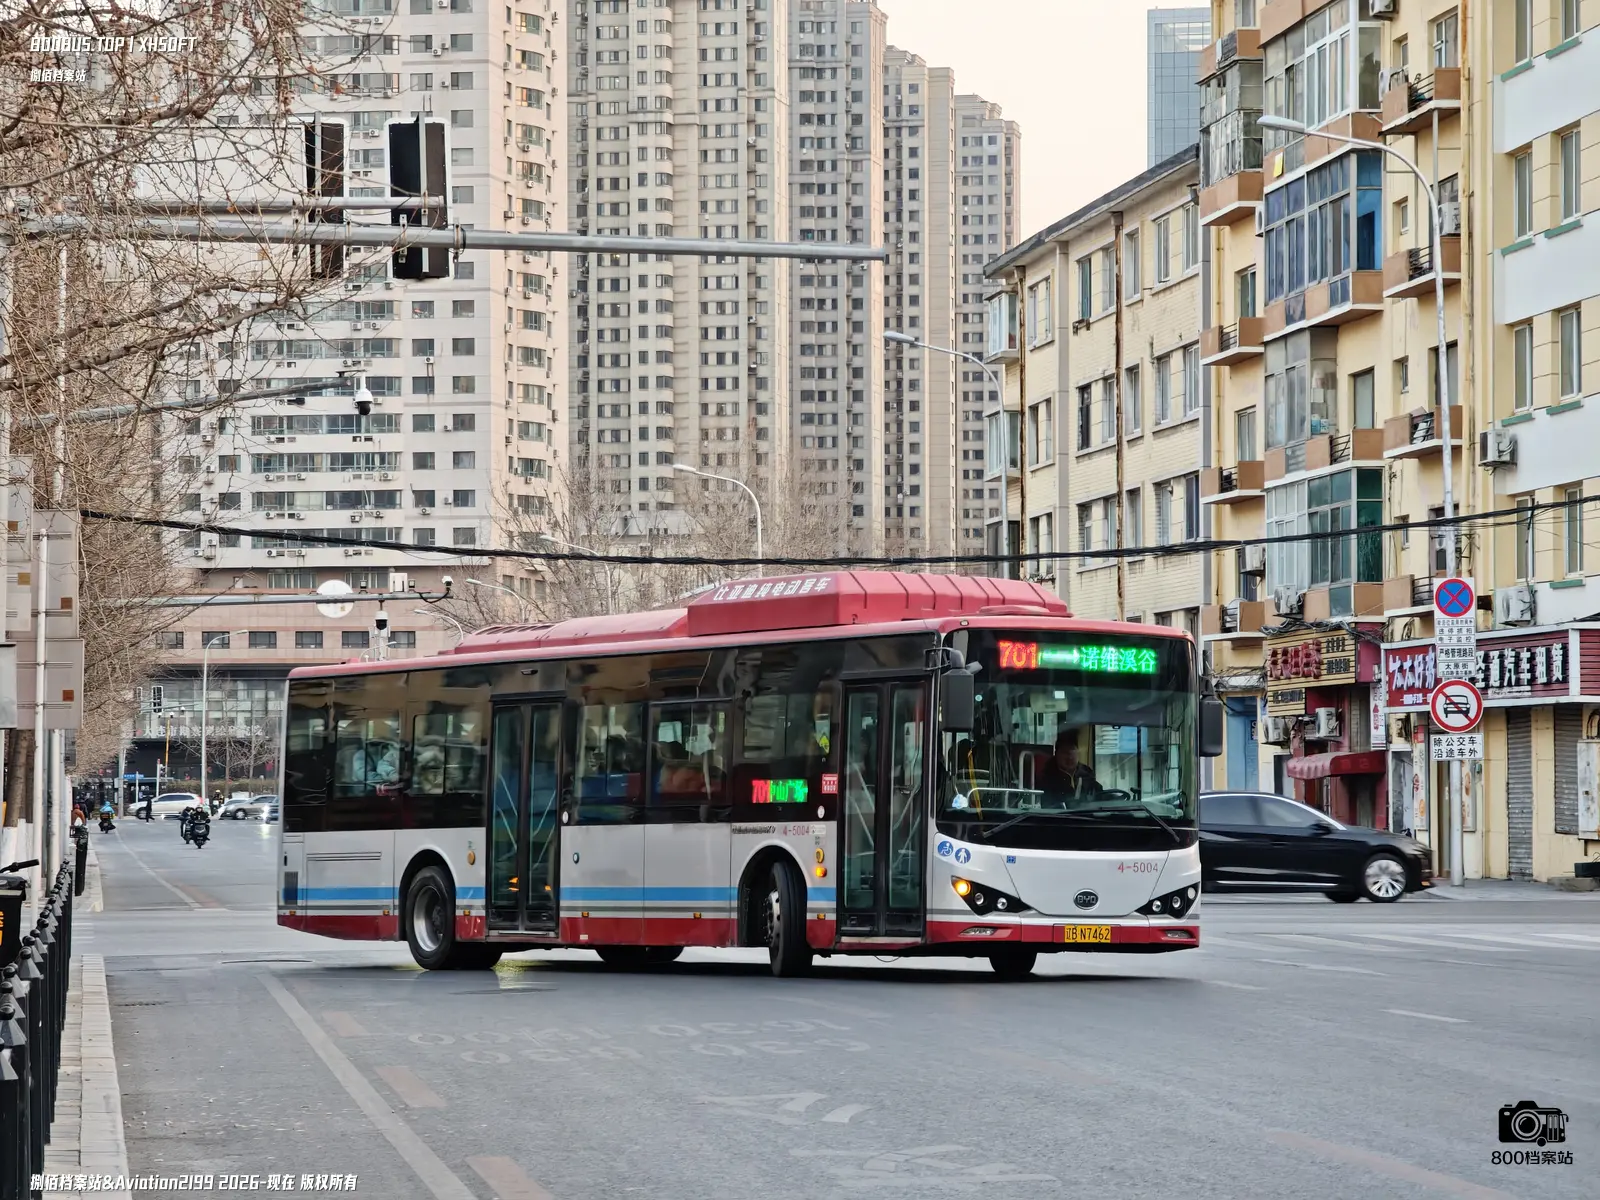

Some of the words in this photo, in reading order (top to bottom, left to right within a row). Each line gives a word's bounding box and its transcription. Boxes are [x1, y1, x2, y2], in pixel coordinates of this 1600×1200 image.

[713, 578, 831, 601] 比亚迪纯电动客车
[999, 641, 1036, 669] 701
[1080, 646, 1157, 672] 诺维溪谷
[1433, 737, 1477, 747] 除公交车
[1434, 748, 1478, 758] 沿途车外
[782, 826, 810, 836] 4-5004
[1117, 861, 1158, 873] 4-5004
[1077, 895, 1096, 904] BYD
